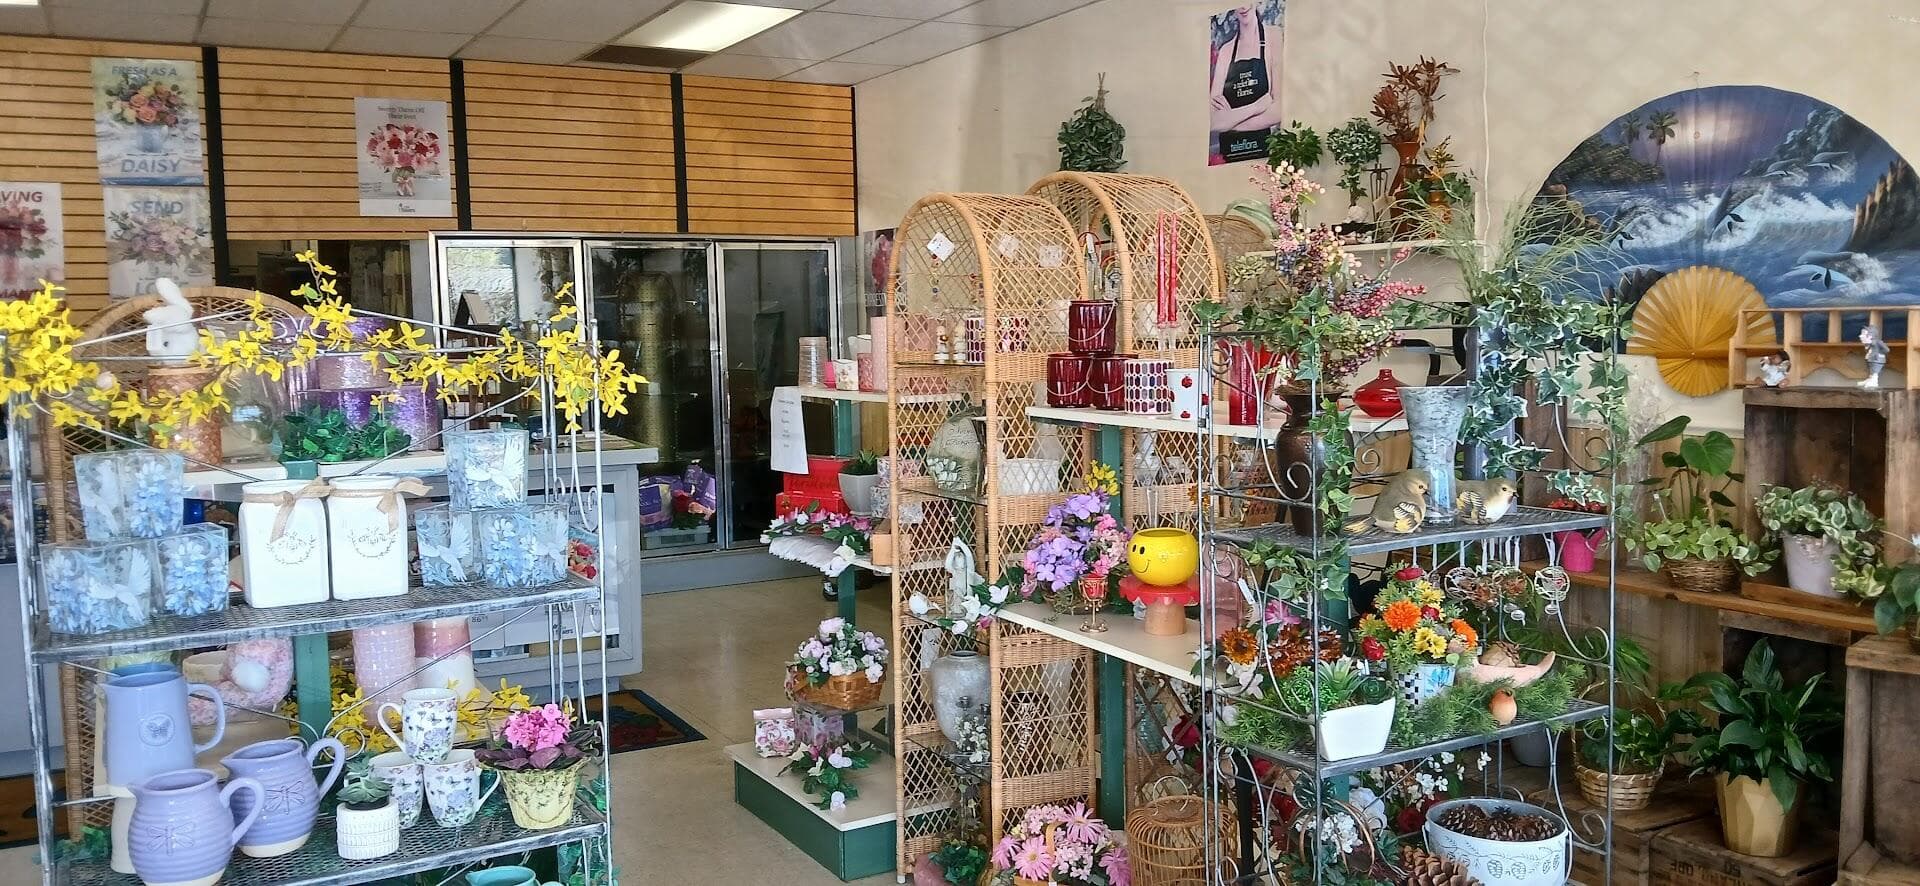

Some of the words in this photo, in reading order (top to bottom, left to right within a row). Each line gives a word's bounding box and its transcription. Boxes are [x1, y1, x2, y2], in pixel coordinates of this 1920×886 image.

[112, 65, 148, 75] FRESH
[151, 67, 167, 76] AS
[168, 67, 177, 76] A
[1239, 71, 1252, 79] trust
[1236, 78, 1258, 89] teleflora
[1230, 138, 1257, 152] teleflora
[121, 159, 181, 173] DAISY
[0, 190, 43, 203] VING
[130, 201, 184, 216] SEND
